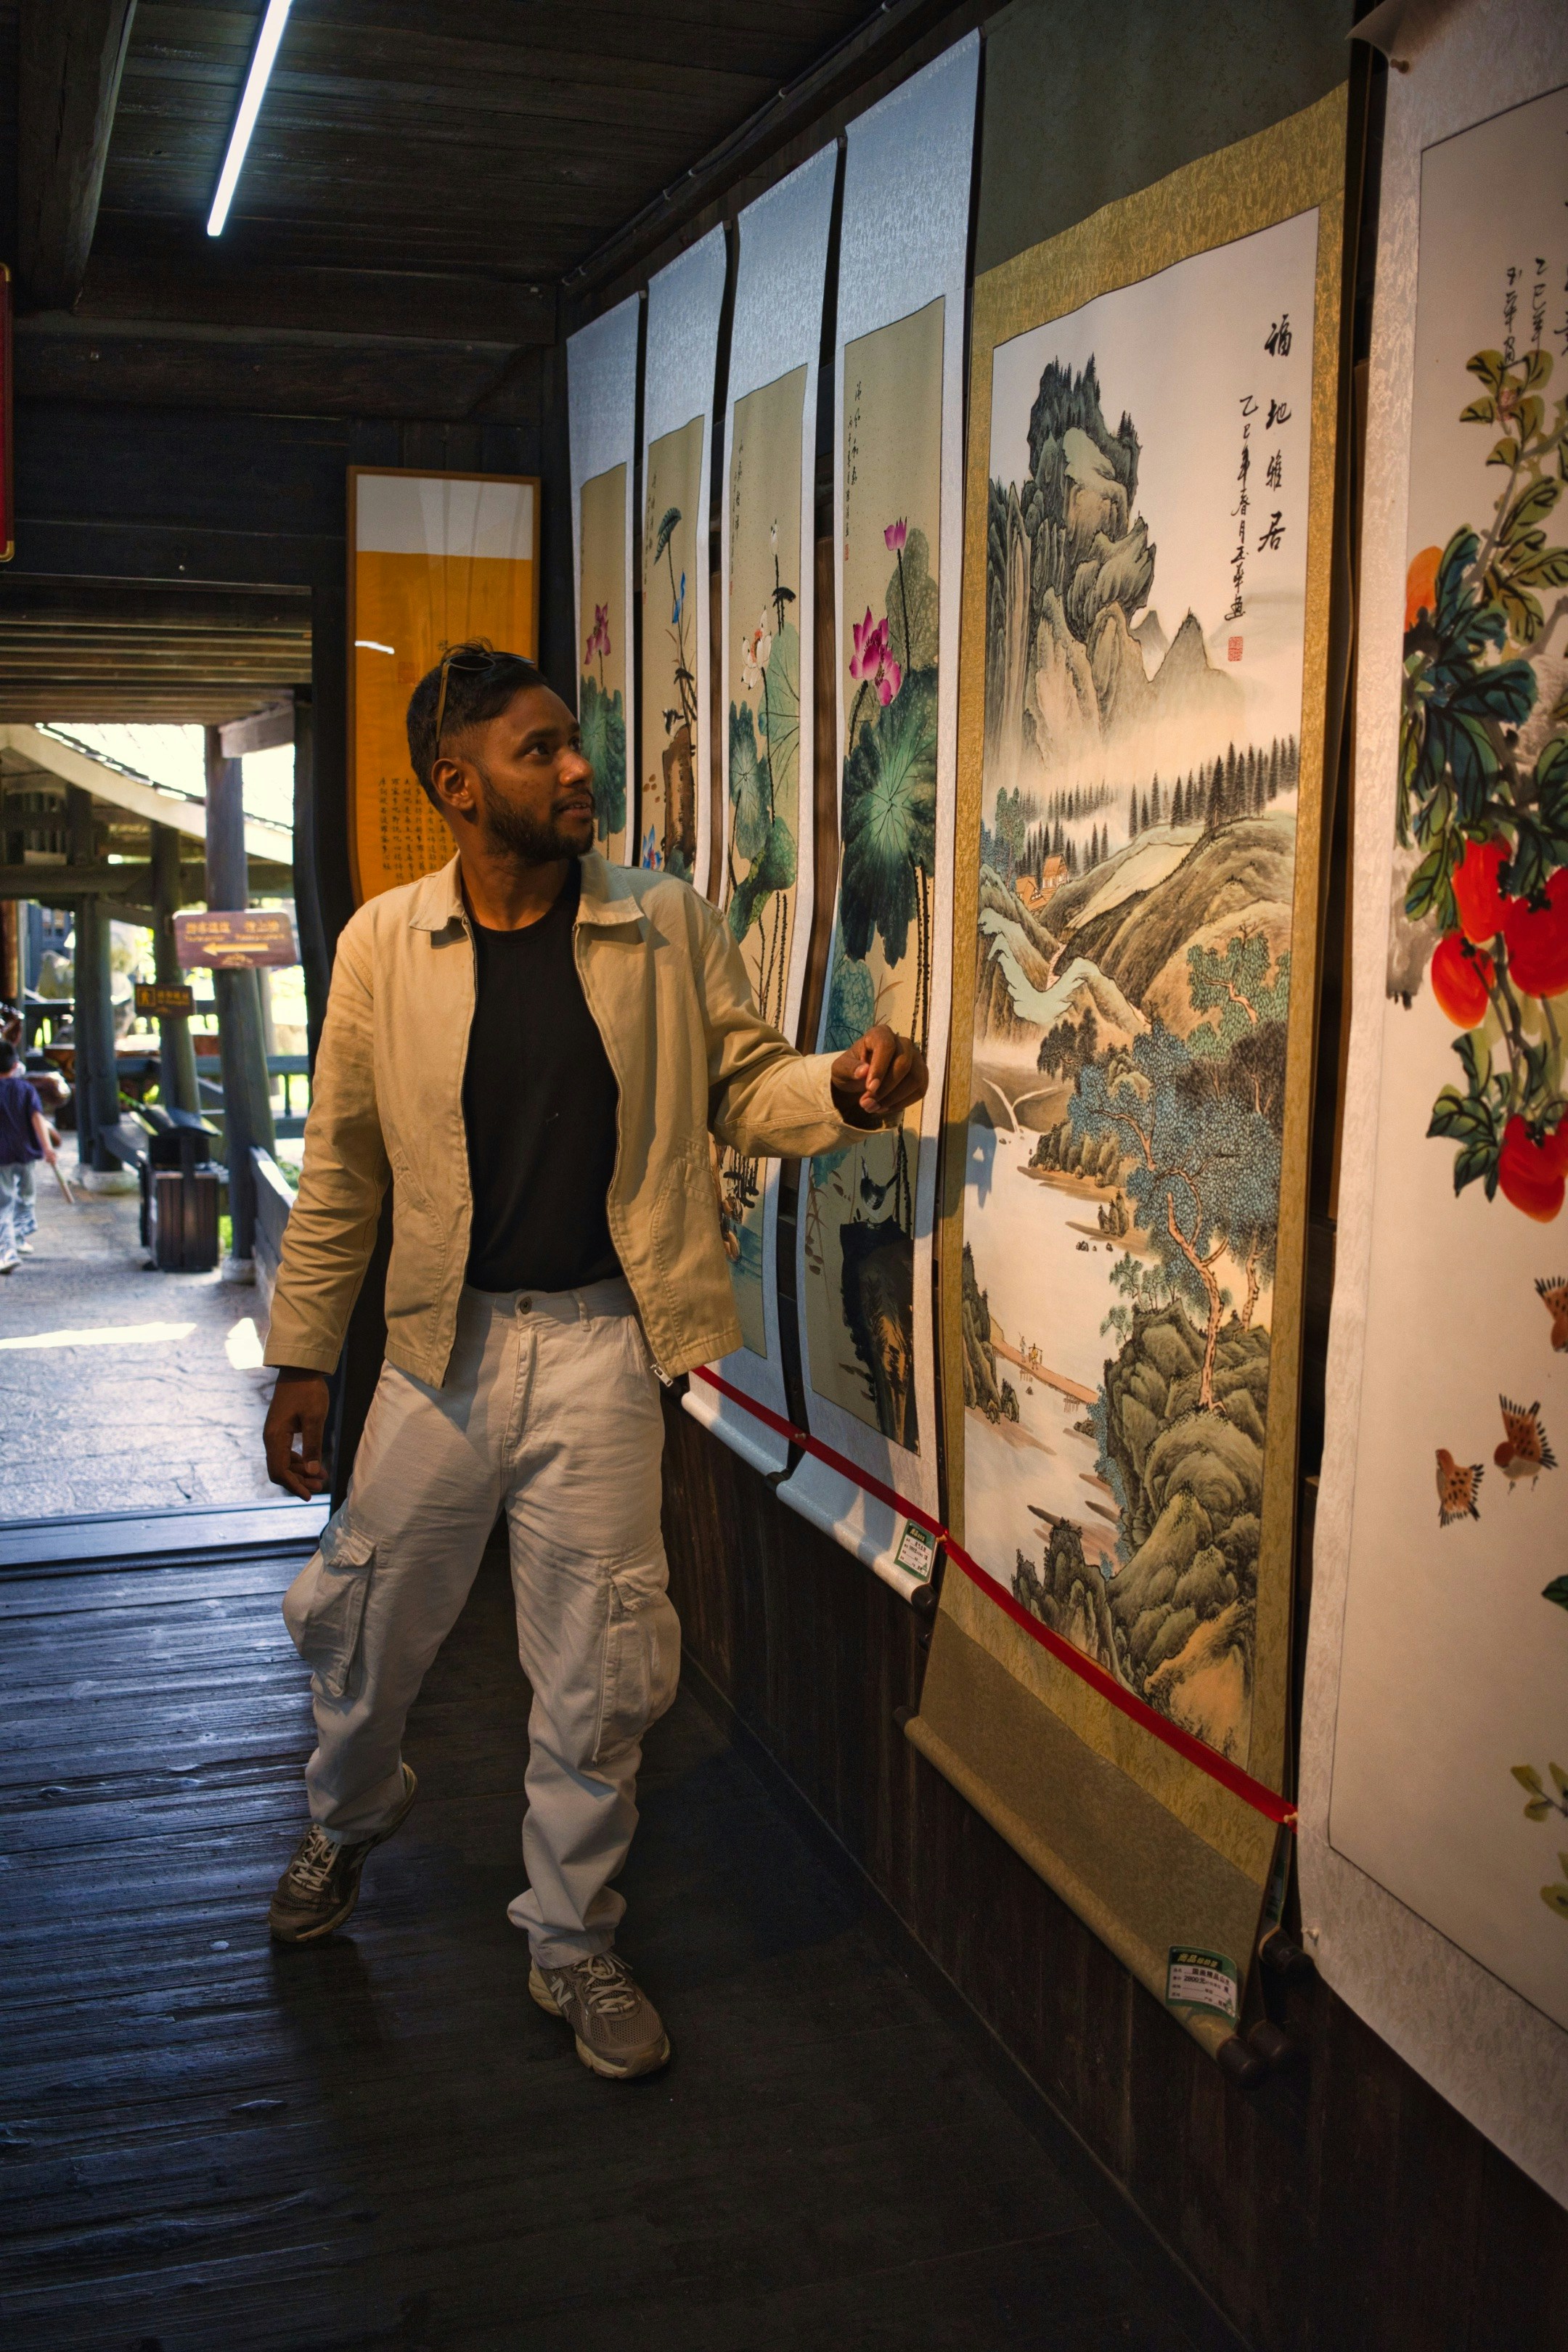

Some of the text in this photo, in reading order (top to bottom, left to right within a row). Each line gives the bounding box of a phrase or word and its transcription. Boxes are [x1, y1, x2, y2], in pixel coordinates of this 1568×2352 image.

[1257, 314, 1292, 552] 福地雅居
[550, 1977, 573, 2007] N
